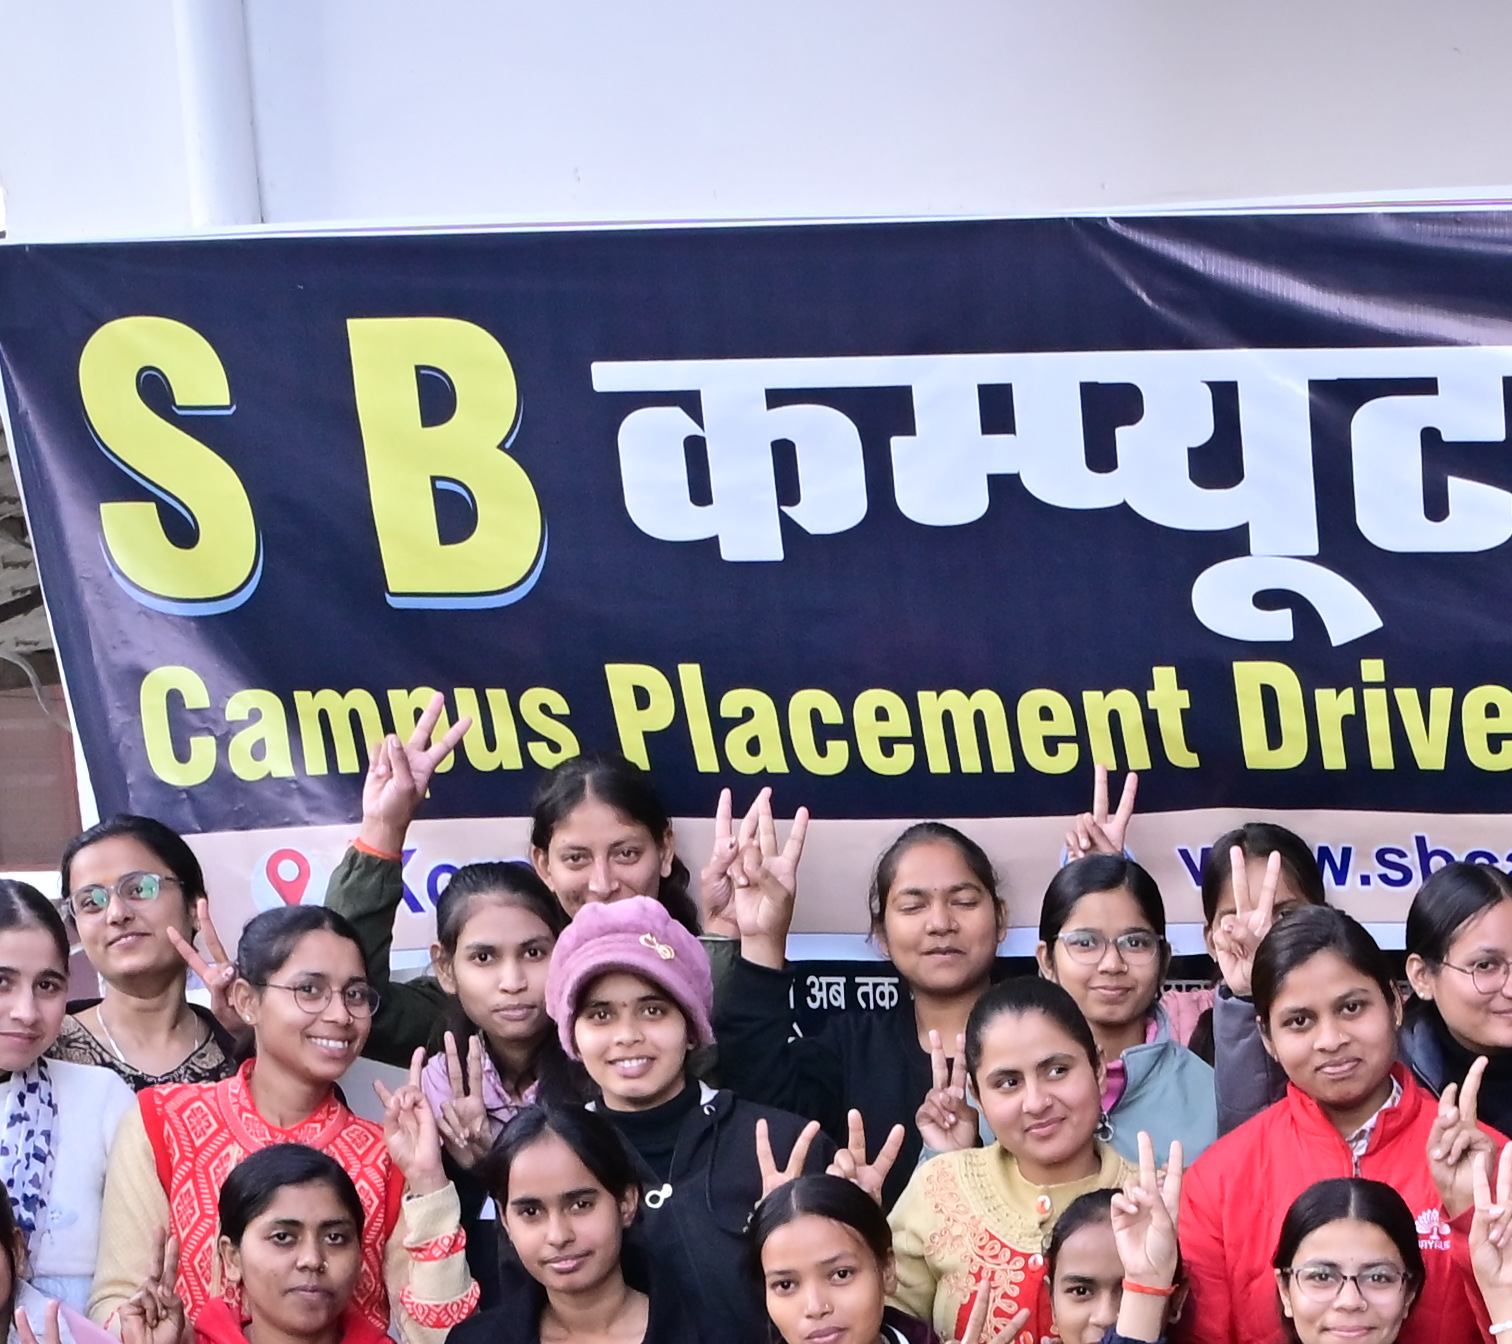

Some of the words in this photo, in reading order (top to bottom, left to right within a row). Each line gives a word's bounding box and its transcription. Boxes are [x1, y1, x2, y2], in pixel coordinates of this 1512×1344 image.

[78, 316, 263, 616] S
[346, 316, 548, 609] B
[604, 661, 1201, 775] Placement
[805, 975, 847, 1011] अब
[854, 975, 900, 1011] तक
